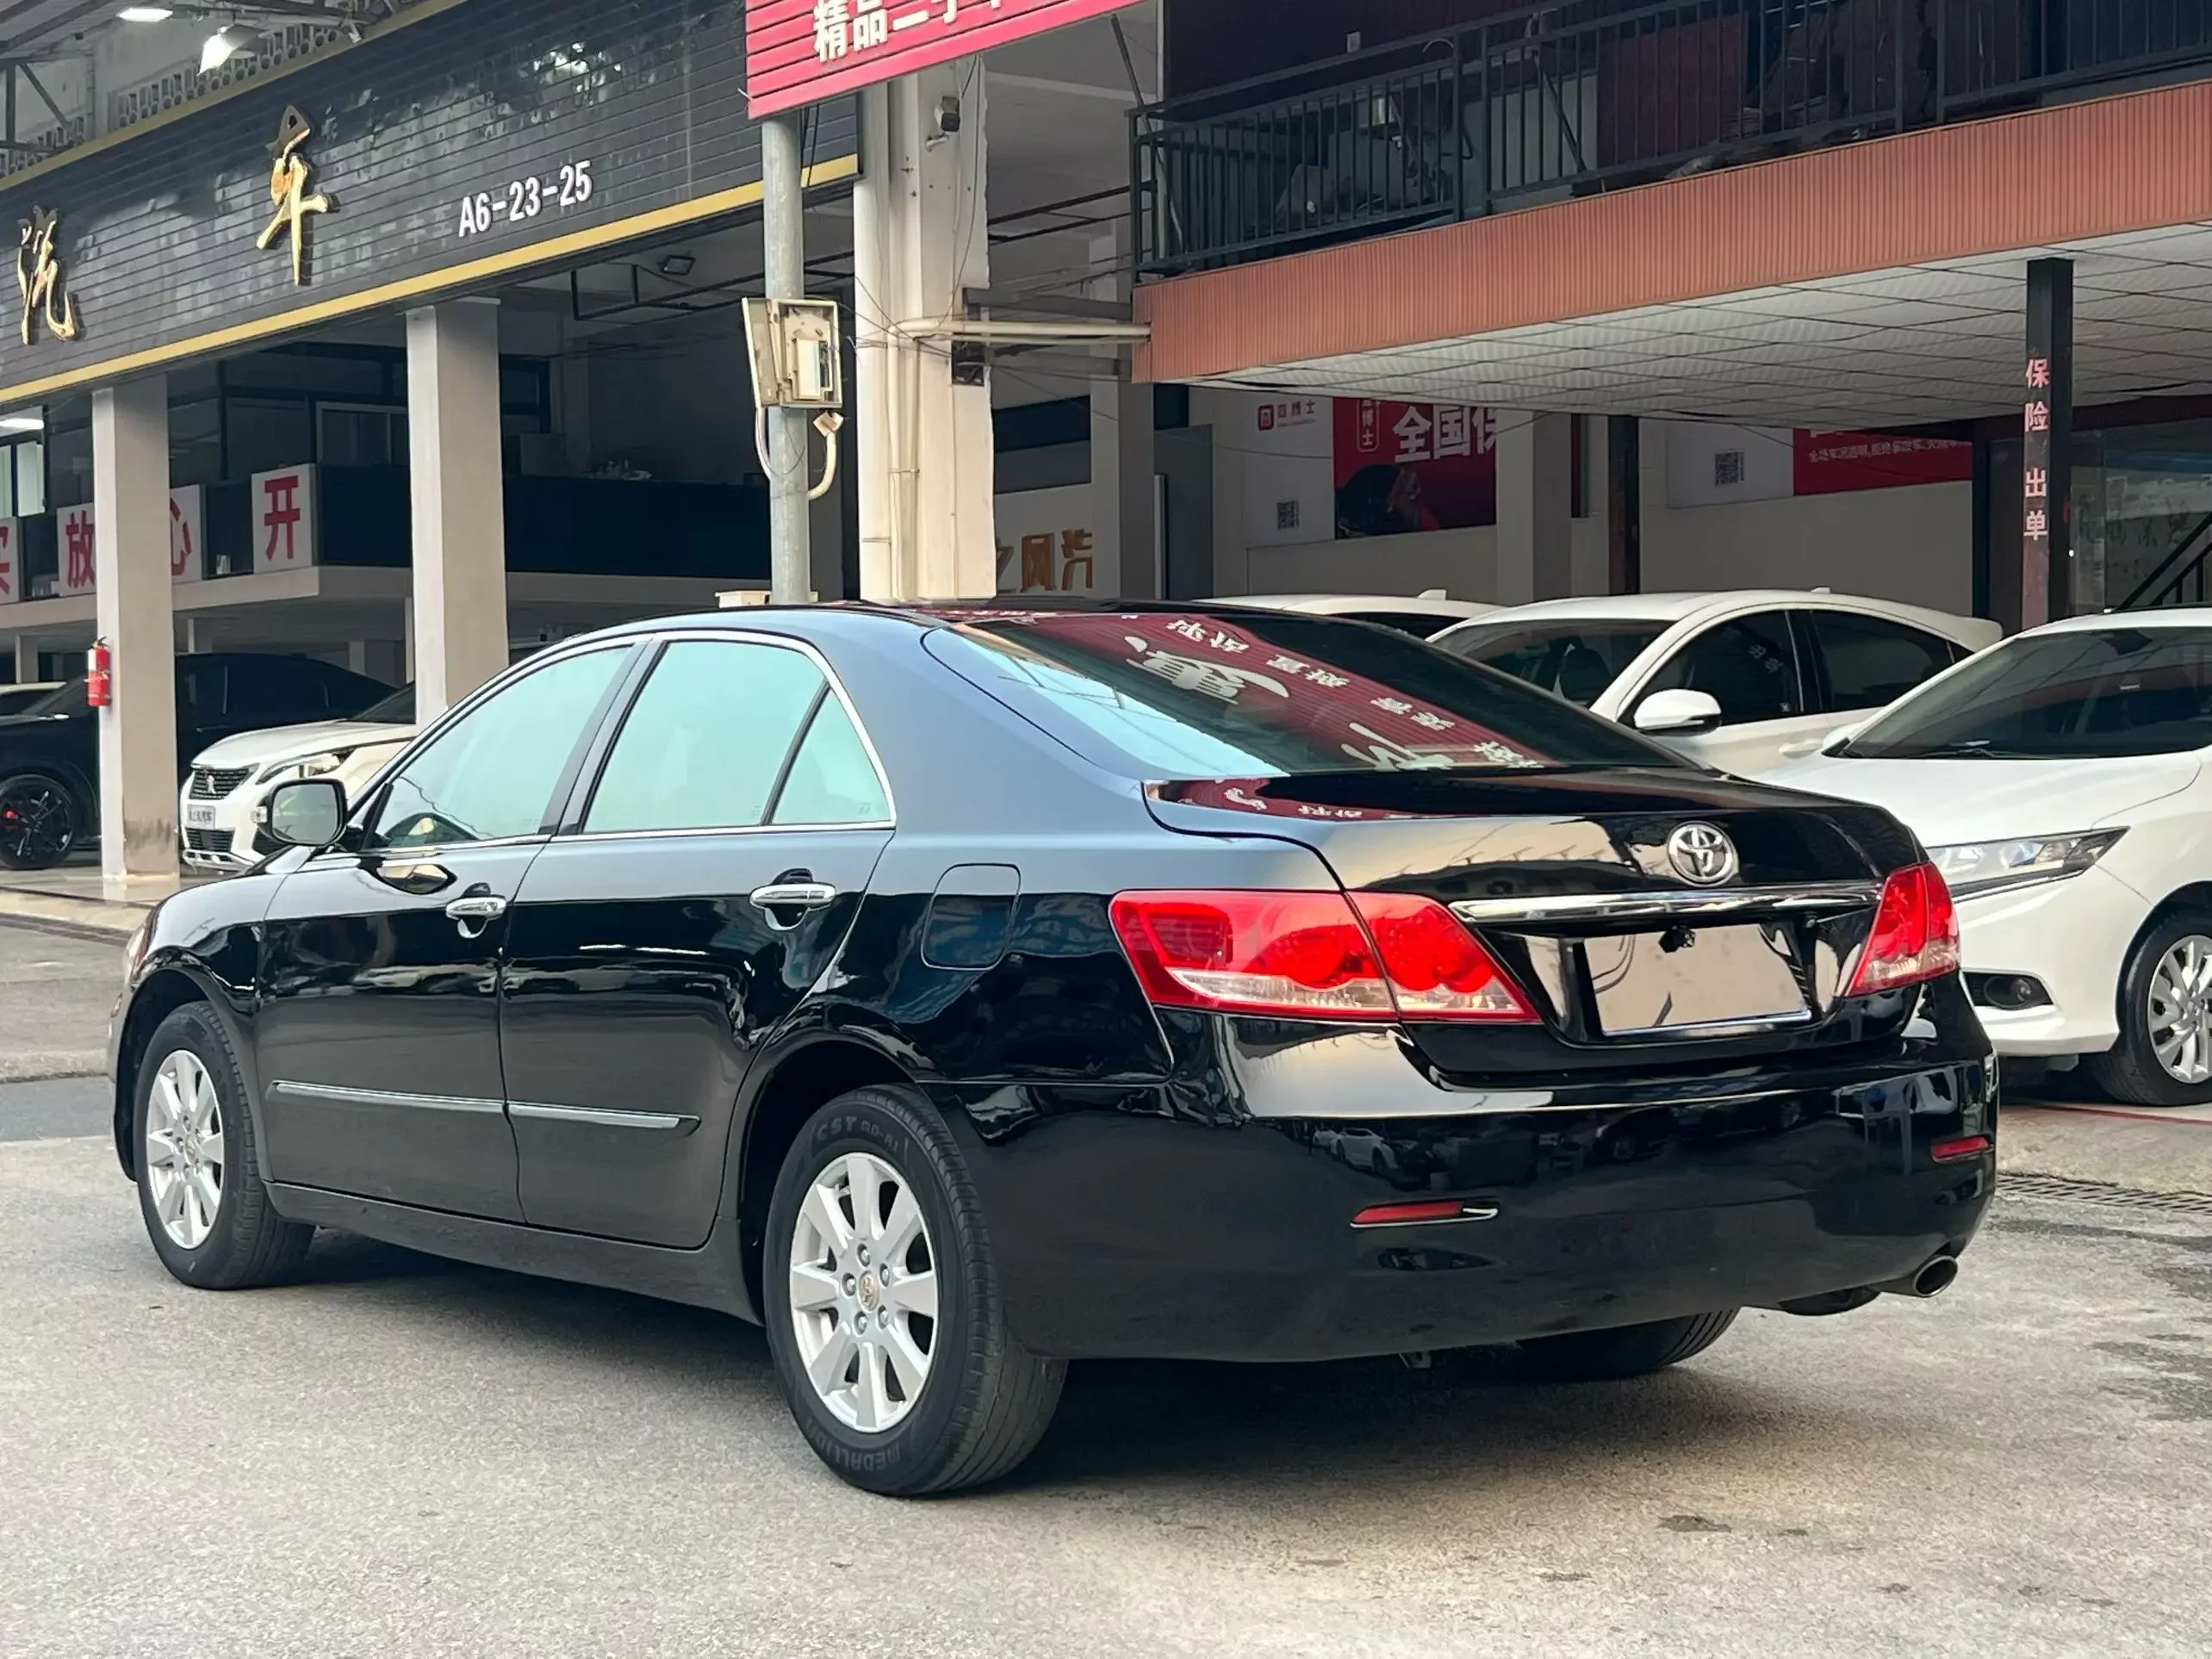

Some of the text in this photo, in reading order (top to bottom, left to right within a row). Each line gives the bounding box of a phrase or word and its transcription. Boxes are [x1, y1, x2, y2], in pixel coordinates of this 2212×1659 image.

[458, 160, 593, 238] A6-23-25
[2023, 358, 2049, 541] 保险出单
[816, 1115, 858, 1140] CST
